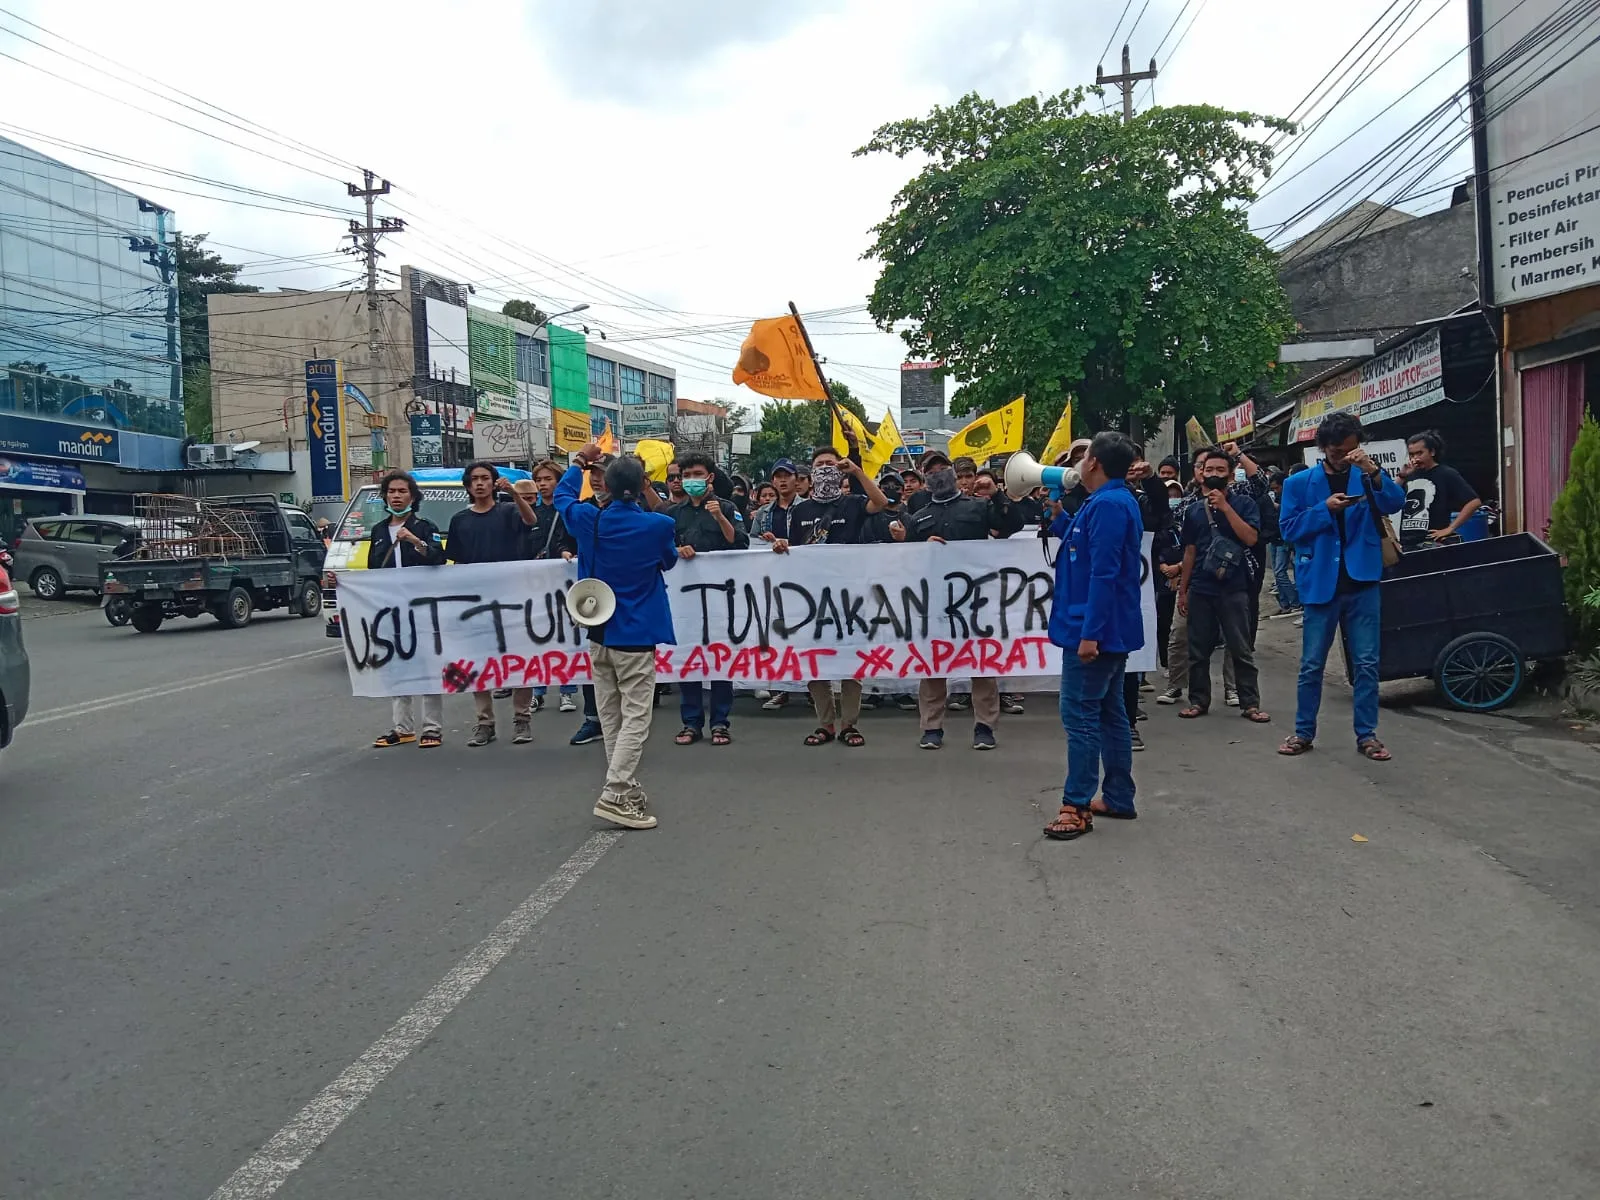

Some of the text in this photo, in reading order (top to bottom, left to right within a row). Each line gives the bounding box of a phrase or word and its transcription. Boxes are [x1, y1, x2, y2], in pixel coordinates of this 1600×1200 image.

[1507, 173, 1570, 204] Pencuci
[1509, 219, 1579, 248] Filter Air
[1510, 236, 1594, 269] Pembersih
[58, 440, 103, 457] mandiri
[320, 406, 337, 470] mandiri
[340, 594, 481, 671] USUT
[460, 580, 581, 653] TUN
[441, 651, 592, 693] #APARA
